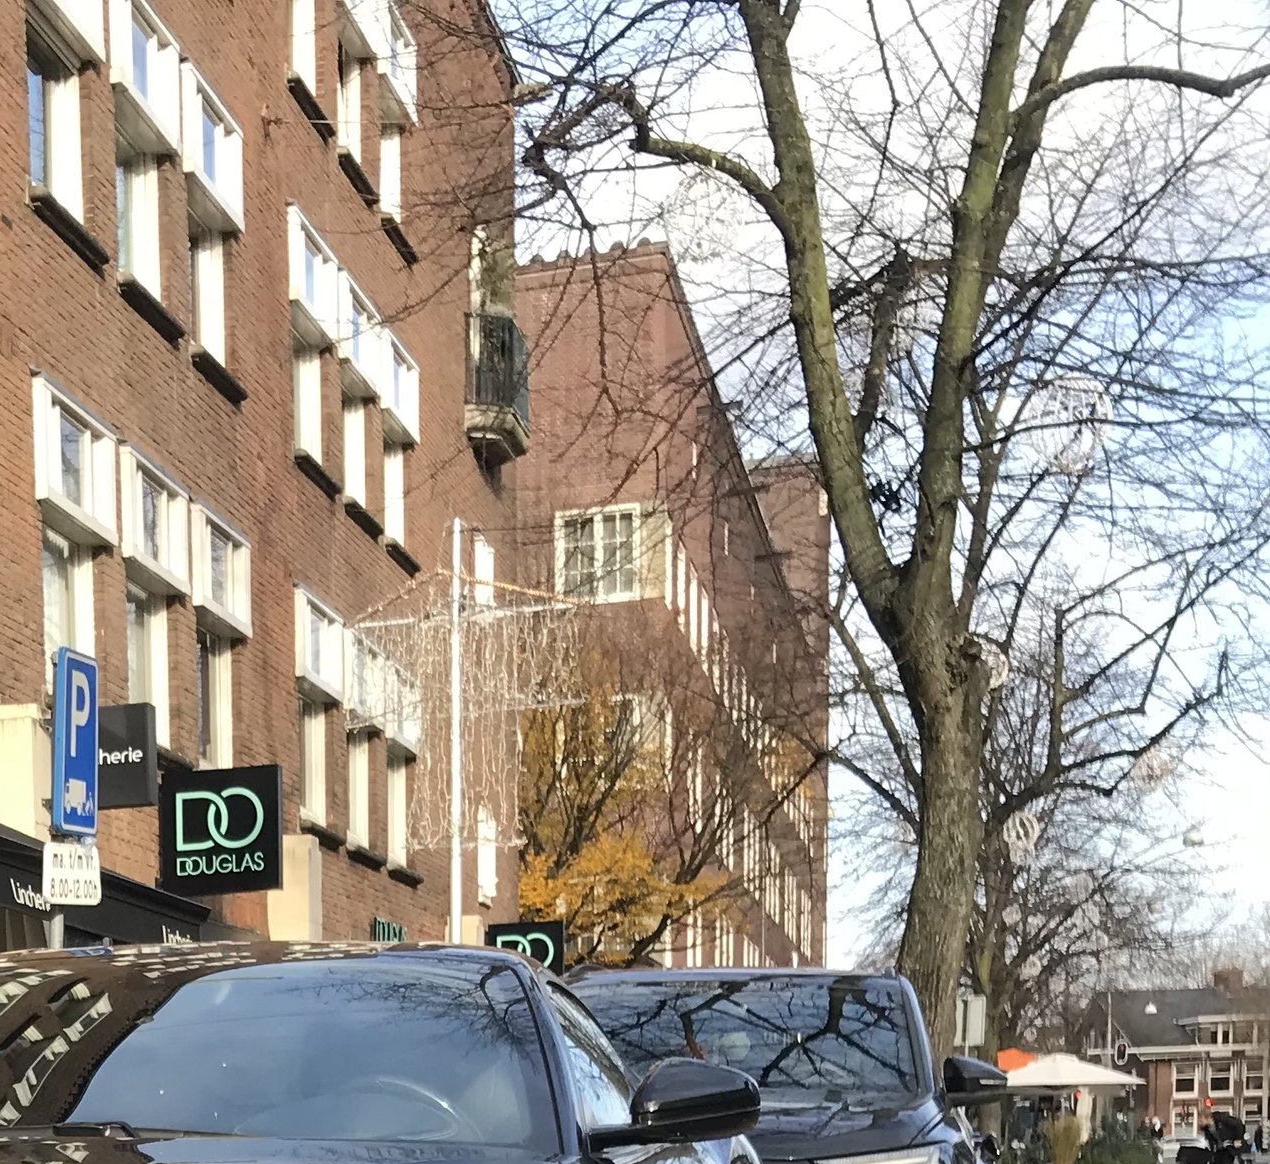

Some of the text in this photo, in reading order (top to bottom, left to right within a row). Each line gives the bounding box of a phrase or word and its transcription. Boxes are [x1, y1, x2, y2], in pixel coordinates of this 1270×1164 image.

[70, 670, 91, 758] P
[98, 747, 143, 765] herie
[176, 852, 265, 876] DOUGLAS
